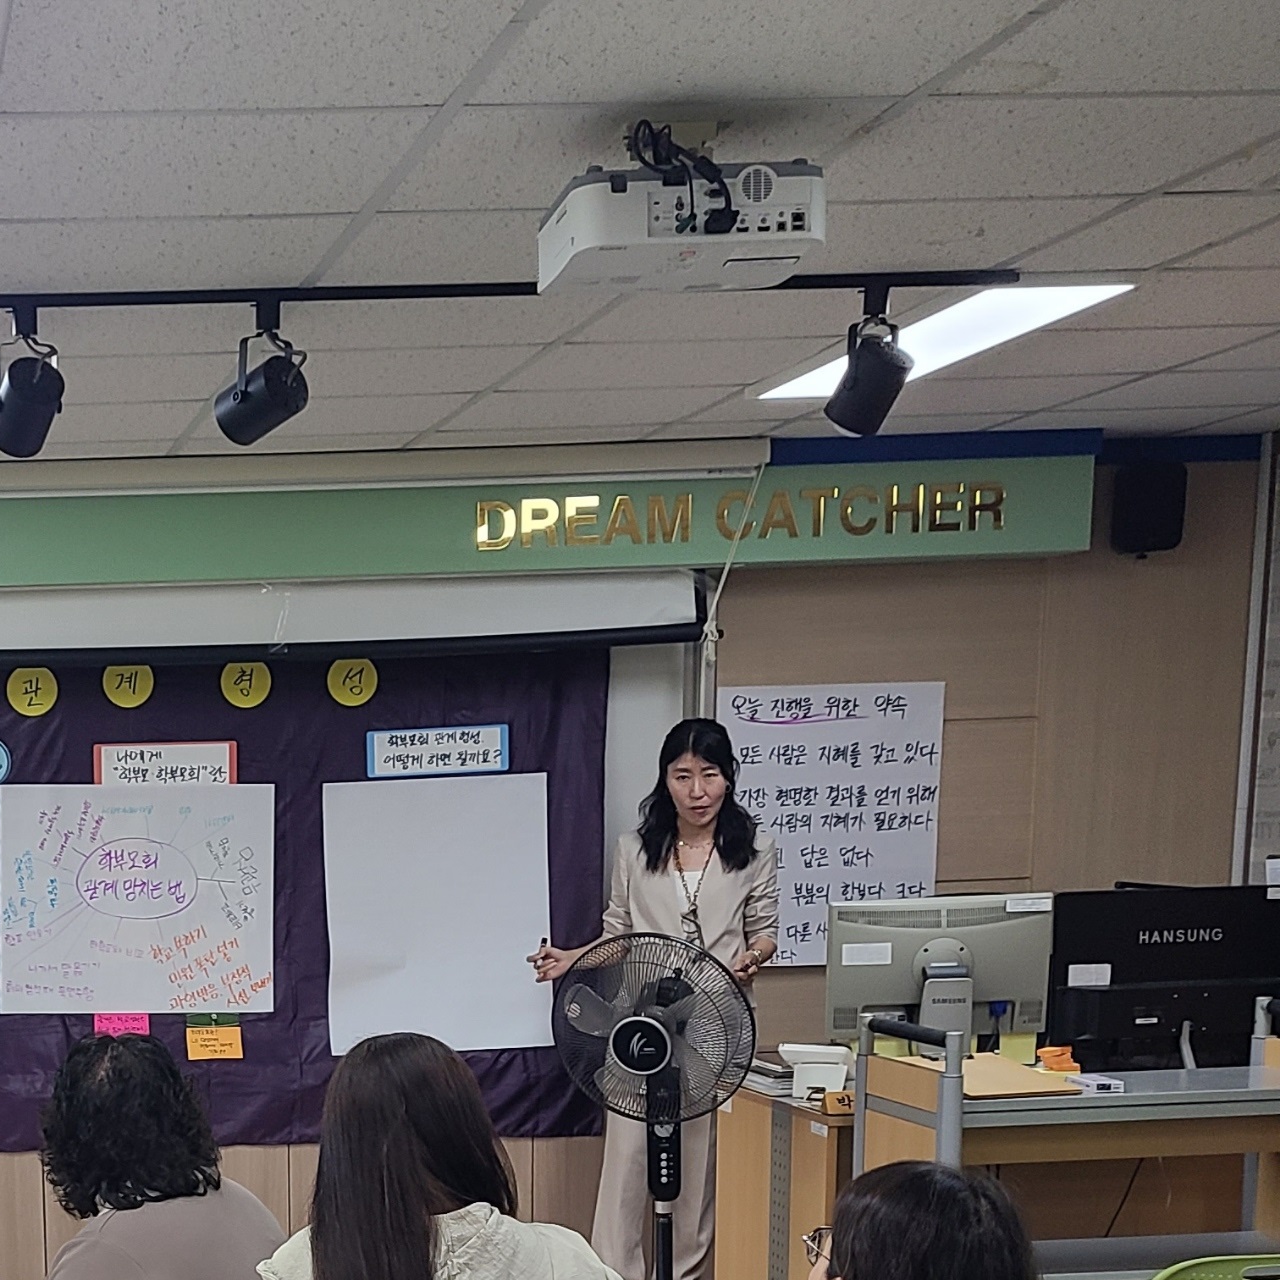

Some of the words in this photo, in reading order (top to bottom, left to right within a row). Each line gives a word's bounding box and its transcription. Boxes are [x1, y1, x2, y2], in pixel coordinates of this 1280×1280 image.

[476, 493, 693, 552] DREAM
[716, 481, 1007, 541] CATCHER
[21, 677, 43, 706] 관
[114, 670, 139, 695] 계
[233, 665, 254, 696] 형
[342, 667, 365, 696] 성
[732, 695, 763, 720] 오늘
[770, 698, 814, 720] 진행을
[824, 697, 860, 719] 위한
[874, 693, 908, 719] 약속
[387, 731, 429, 748] 학부모회
[117, 749, 162, 764] 나에게
[383, 750, 423, 770] 어떻게
[427, 751, 452, 766] 하면
[455, 749, 503, 765] 될까요?
[739, 745, 763, 765] 모든
[769, 745, 808, 766] 사람은
[818, 742, 862, 768] 지혜를
[870, 742, 899, 765] 갖고
[739, 787, 769, 809] 가장
[775, 786, 819, 808] 현명한
[825, 785, 869, 807] 결과를
[875, 786, 902, 806] 얻기
[906, 784, 937, 804] 위해
[770, 812, 812, 834] 사람의
[821, 812, 866, 833] 지혜가
[98, 847, 159, 872] 학부모회
[800, 845, 829, 869] 답은
[839, 845, 874, 868] 없다
[83, 878, 121, 901] 관계
[123, 877, 163, 901] 망치는
[167, 880, 187, 904] 법
[791, 882, 831, 906] 부분의
[896, 881, 927, 898] 크다
[786, 922, 812, 944] 다른
[1138, 928, 1224, 945] HANSUNG
